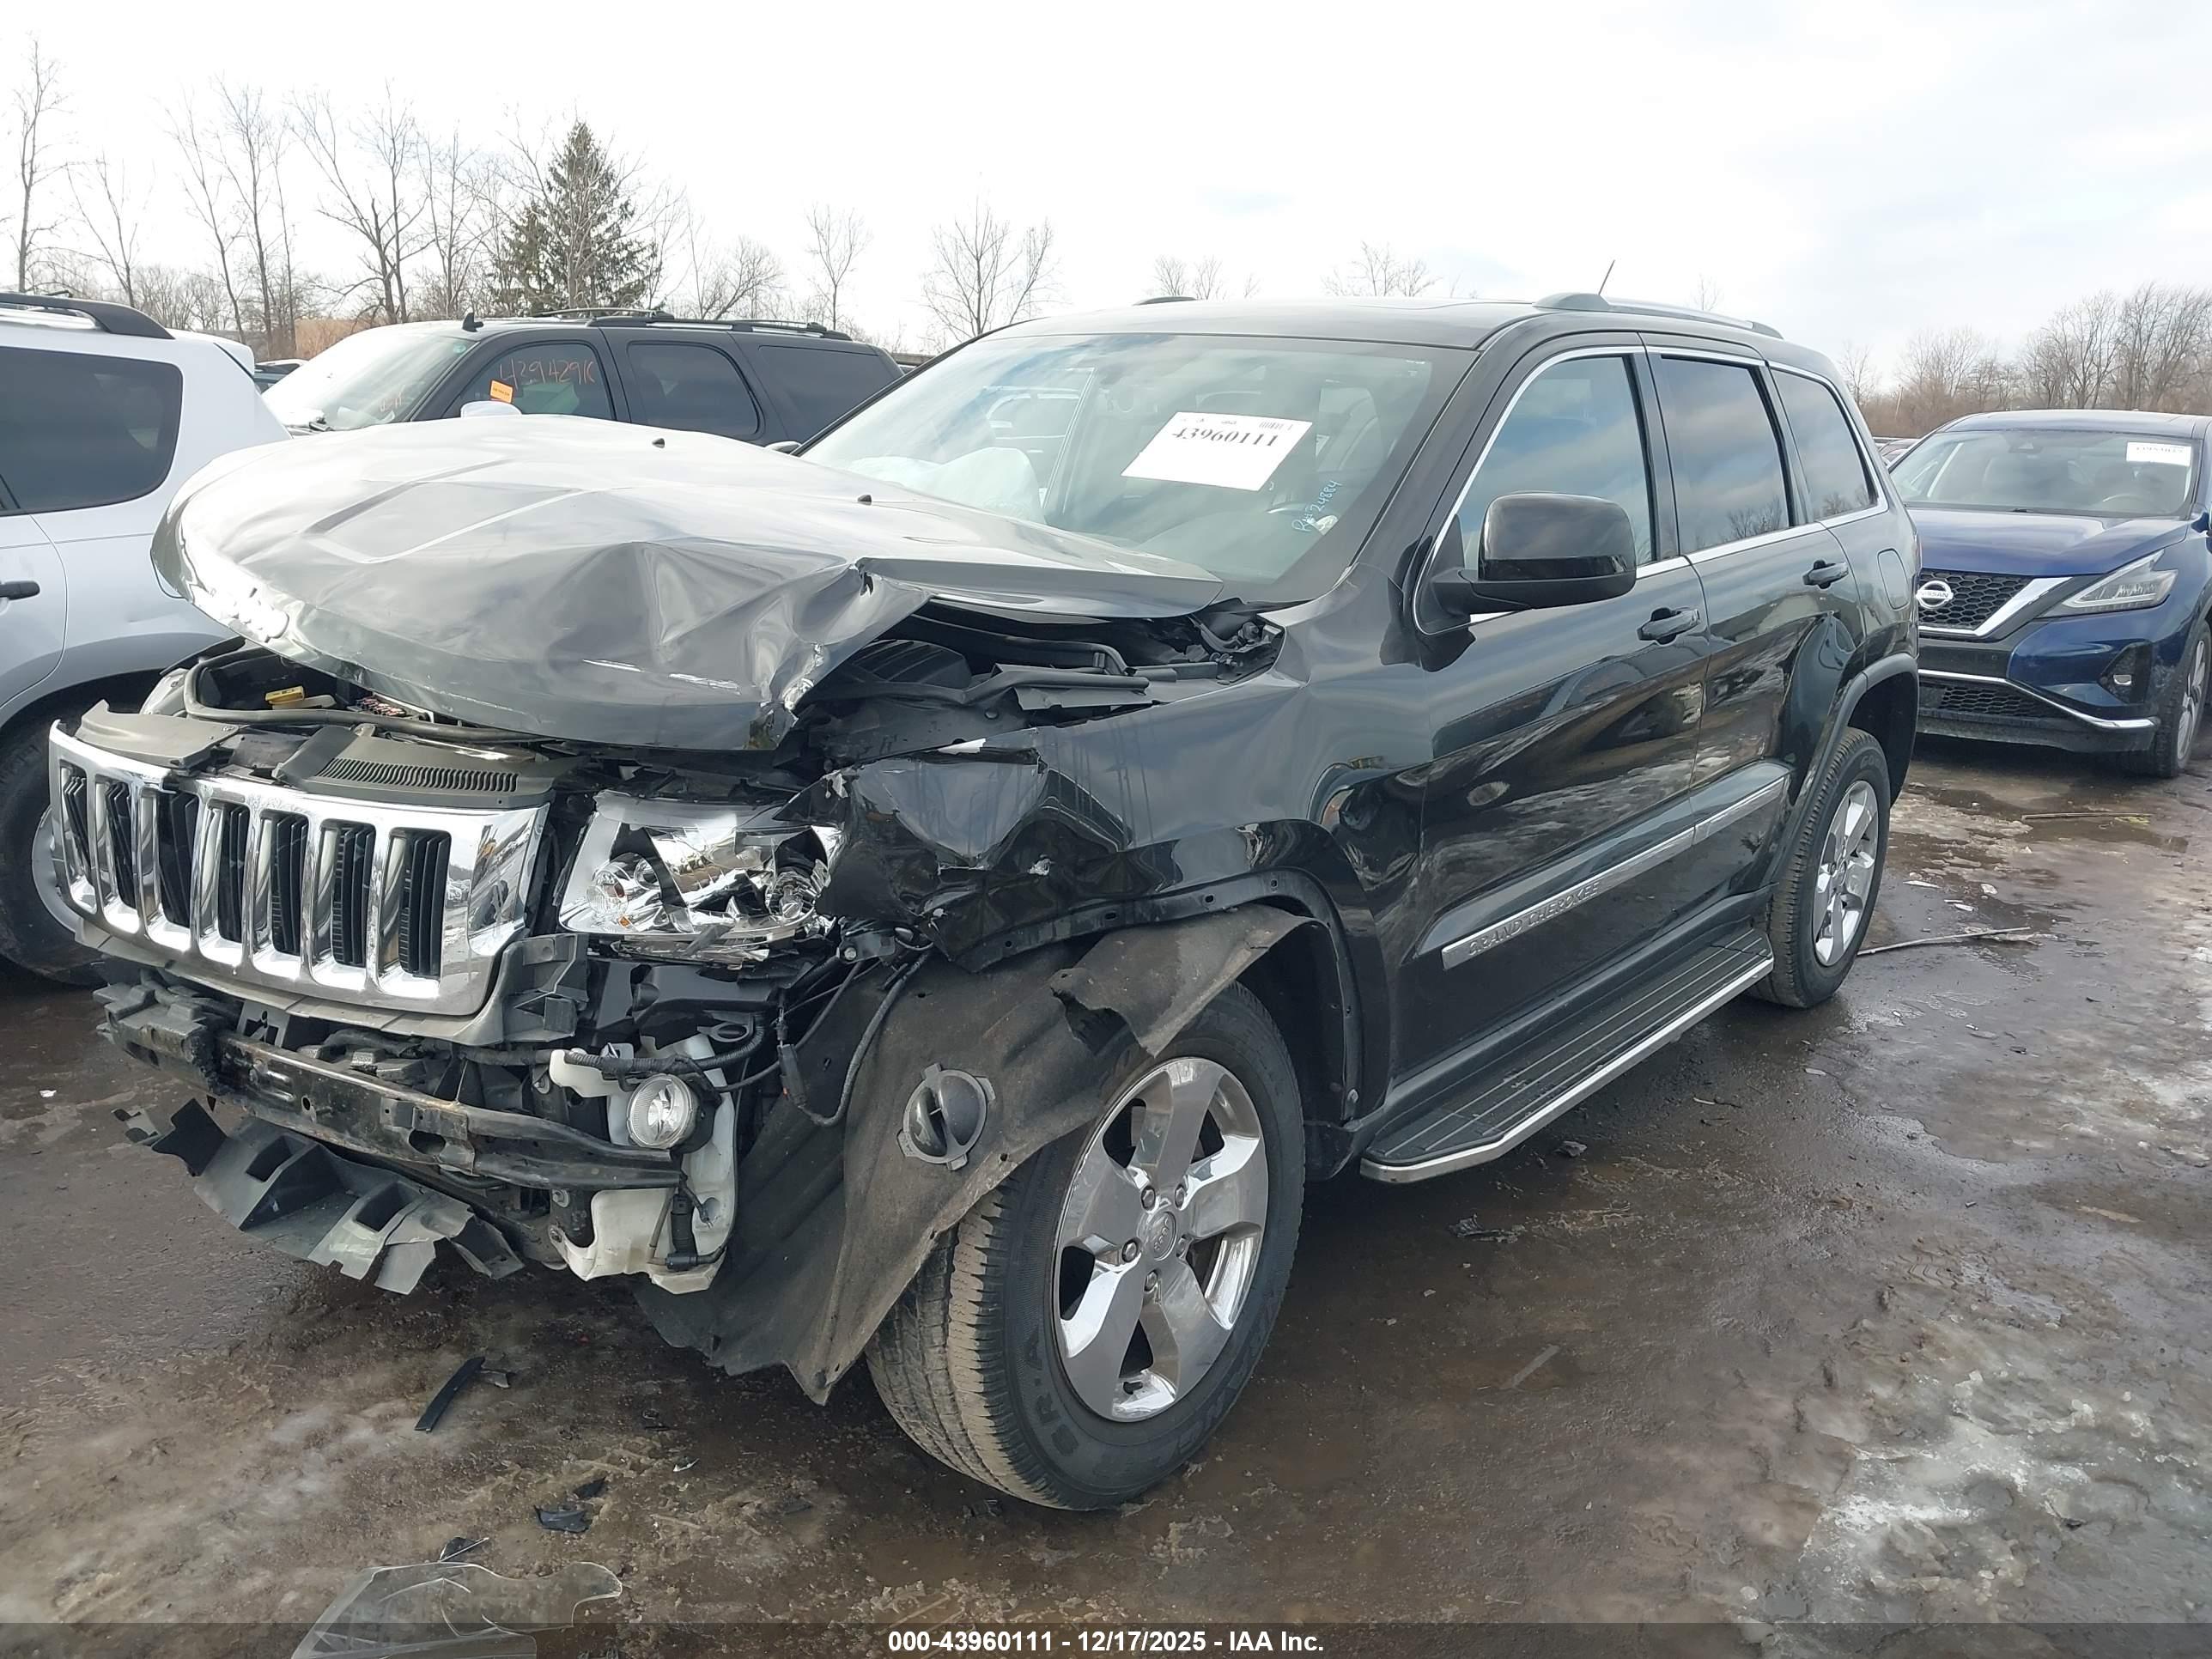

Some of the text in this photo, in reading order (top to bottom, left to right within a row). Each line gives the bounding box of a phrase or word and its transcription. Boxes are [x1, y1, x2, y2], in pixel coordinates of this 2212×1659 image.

[1171, 427, 1279, 447] 43960111
[1468, 881, 1601, 957] GRAND CHEROKEE
